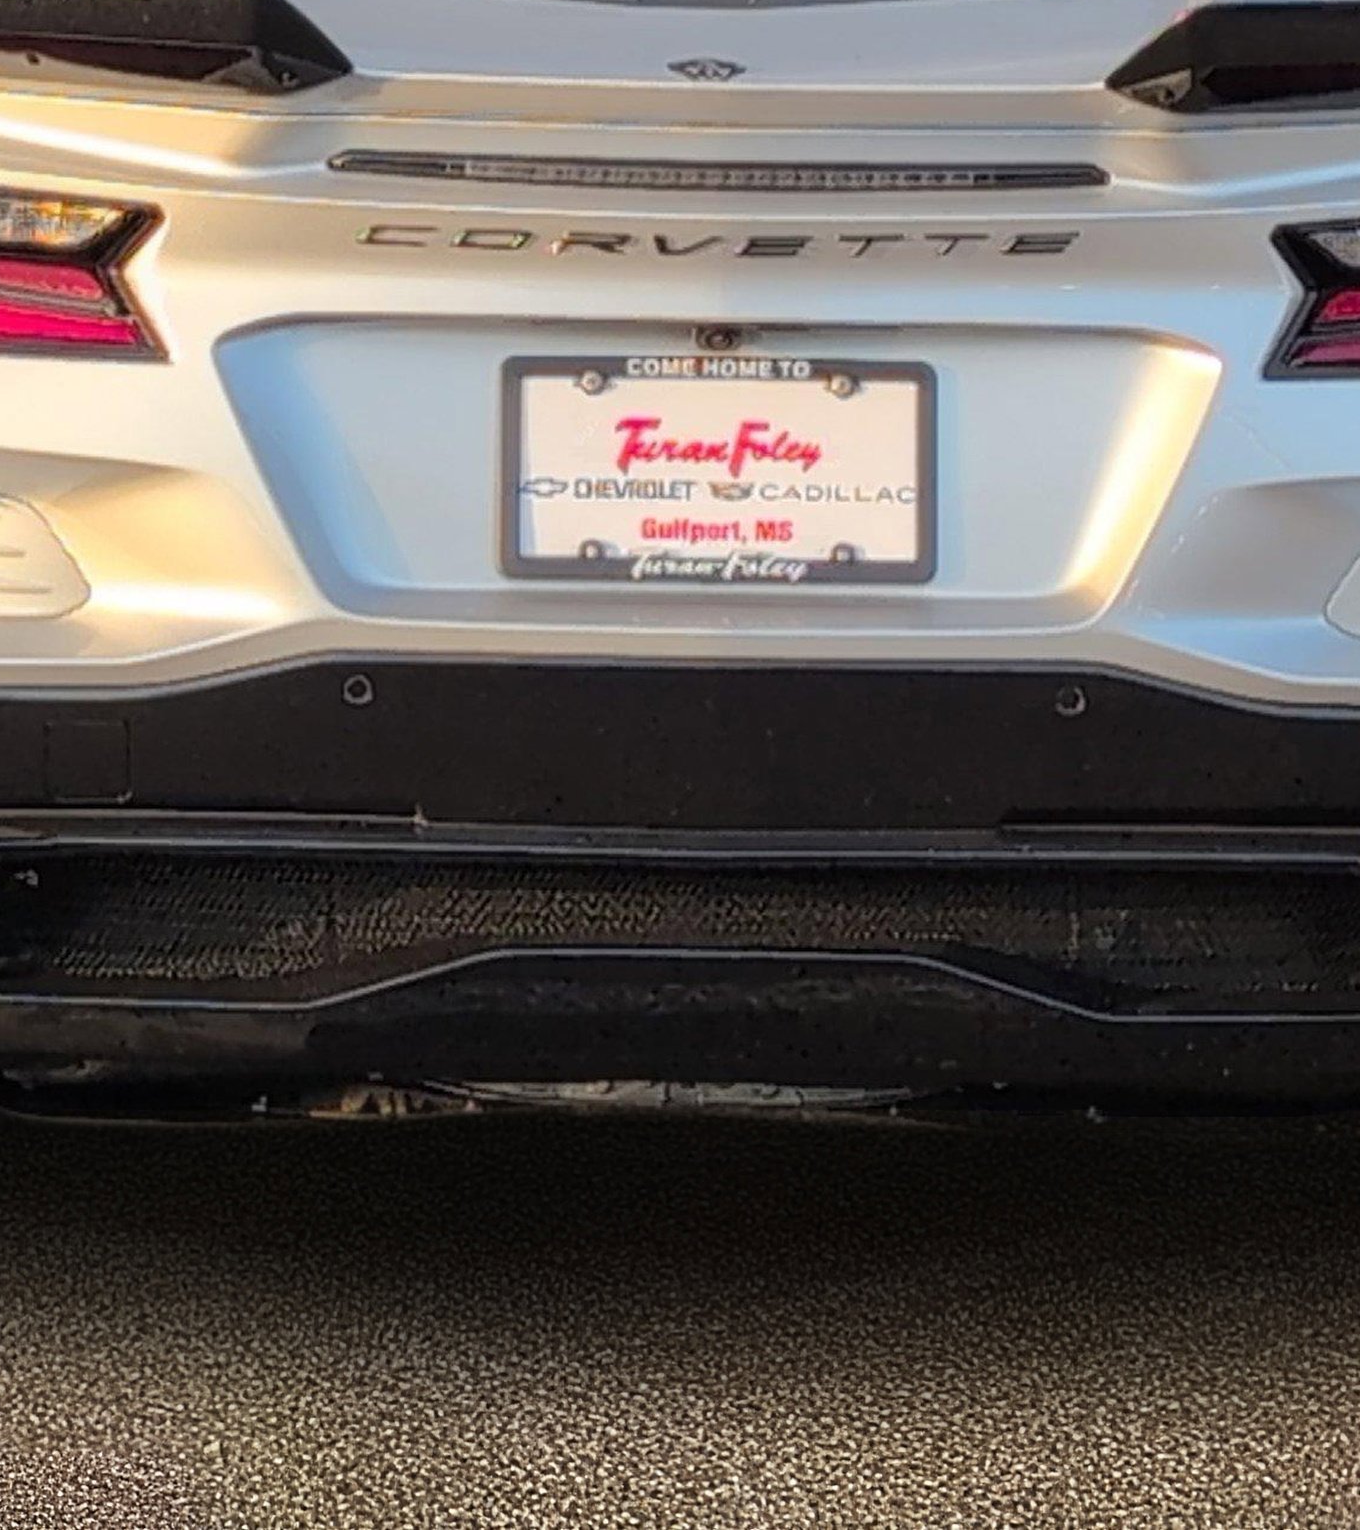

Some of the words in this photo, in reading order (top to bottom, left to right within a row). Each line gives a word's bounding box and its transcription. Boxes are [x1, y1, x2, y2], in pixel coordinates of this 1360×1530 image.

[354, 223, 1081, 259] CORVETTE
[626, 356, 696, 378] COME
[701, 358, 775, 379] HOME
[779, 360, 812, 379] TO
[615, 417, 729, 473] Turan
[727, 422, 822, 477] Foley
[573, 479, 695, 501] CHEVROLET
[758, 484, 916, 504] CADILLAC
[641, 517, 746, 544] Gulfport,
[754, 520, 793, 542] MS
